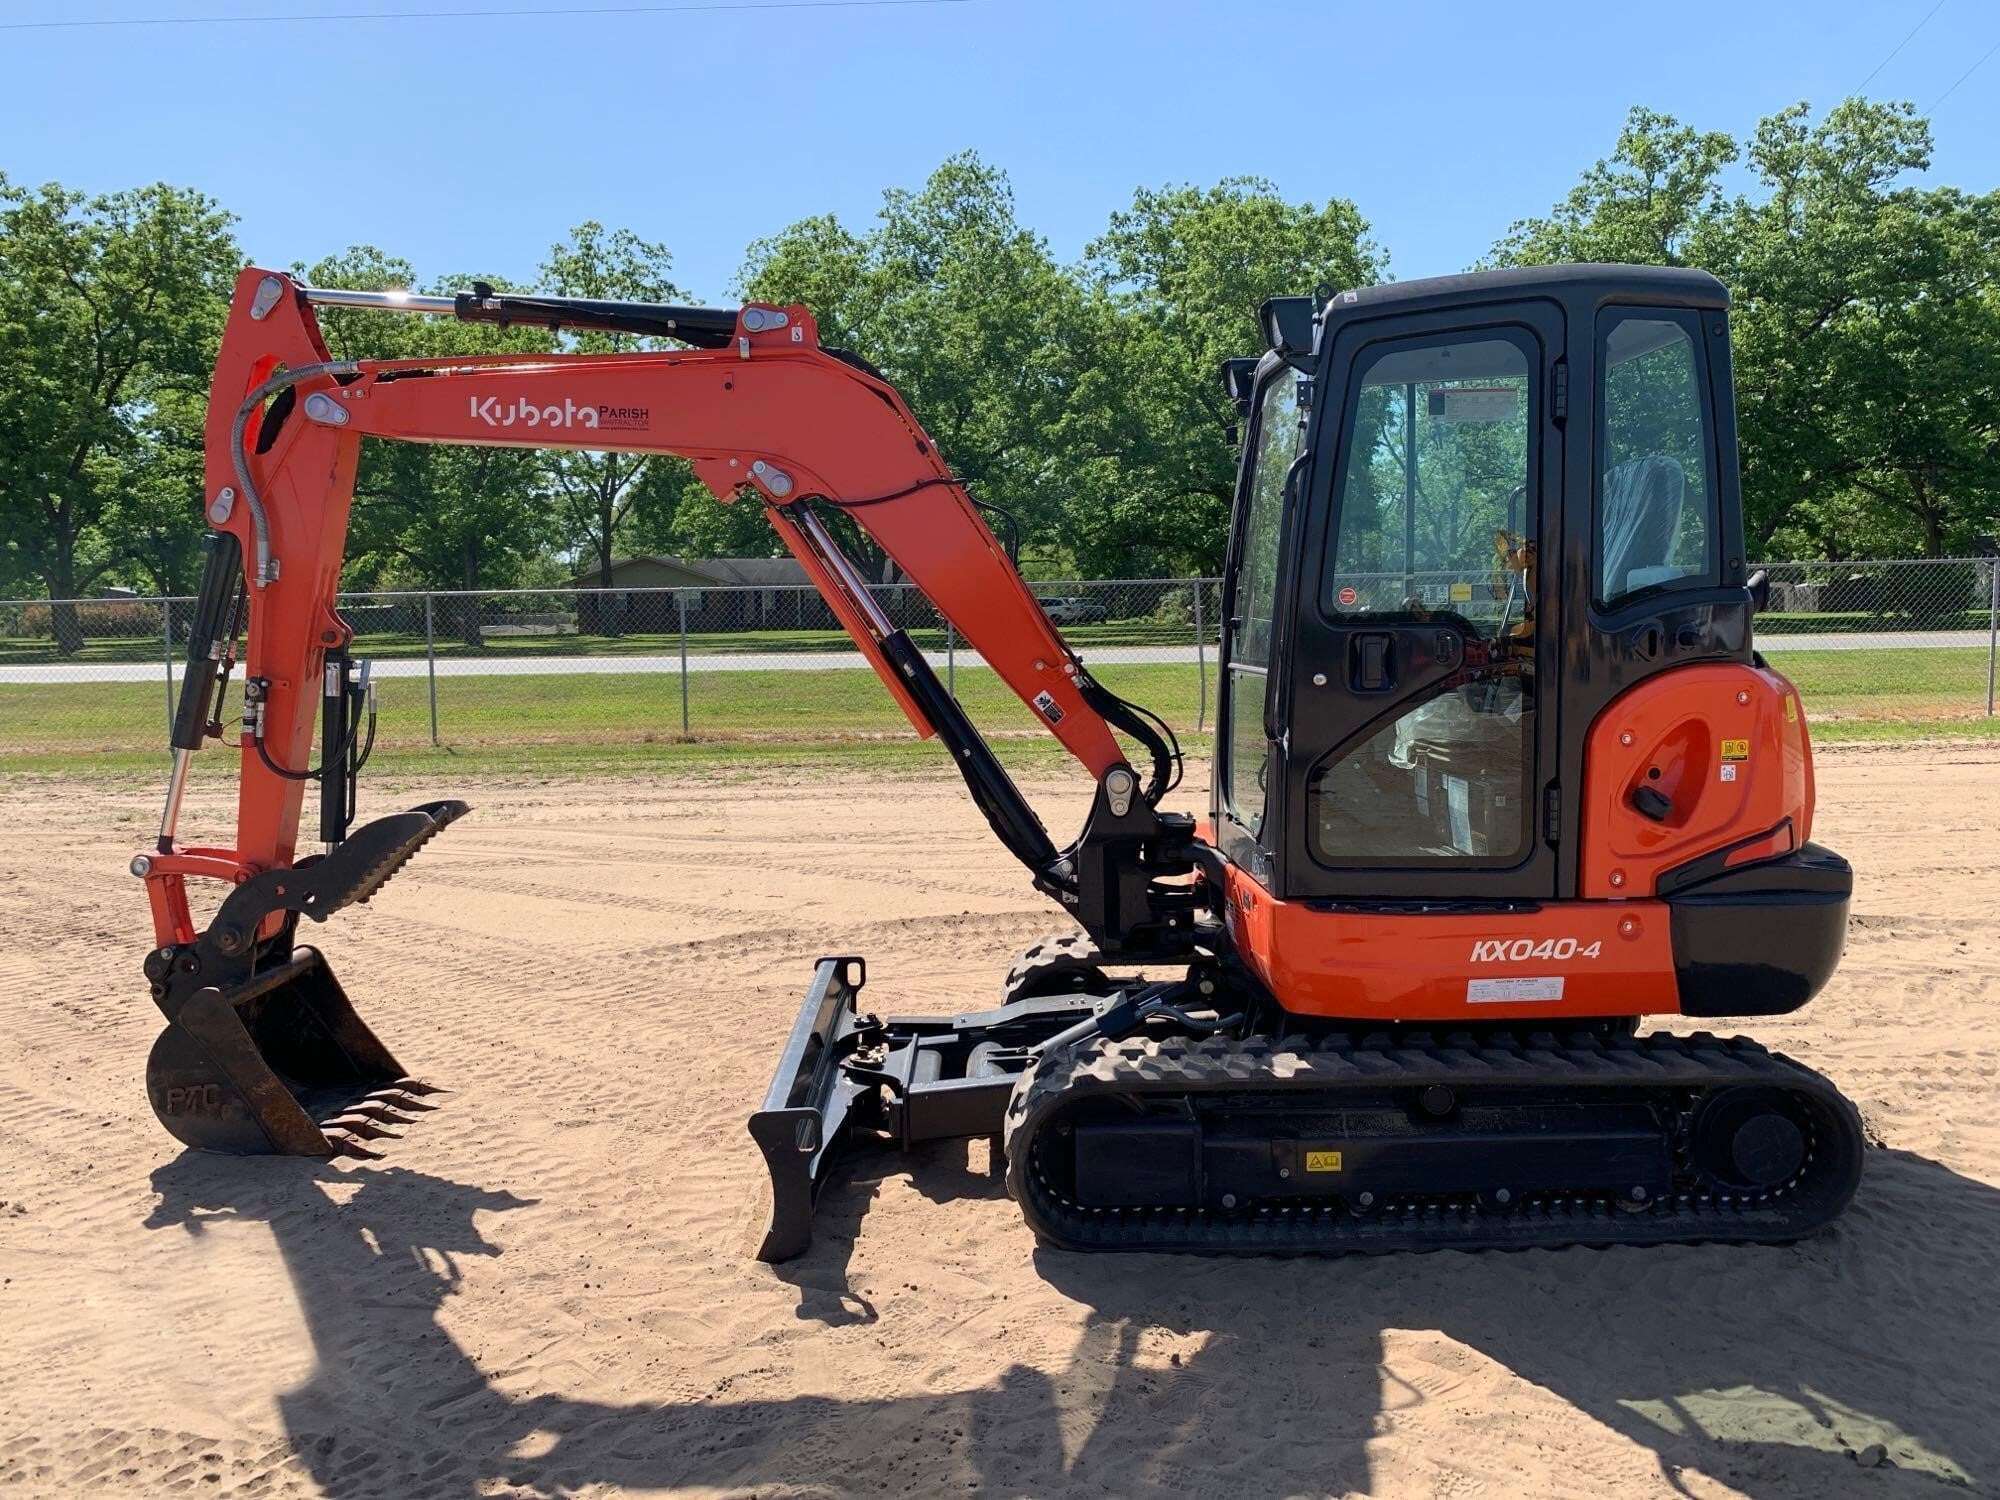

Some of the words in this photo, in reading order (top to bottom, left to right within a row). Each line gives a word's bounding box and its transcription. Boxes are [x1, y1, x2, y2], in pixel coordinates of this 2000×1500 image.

[470, 396, 598, 427] Kubota
[599, 405, 649, 419] PARISH
[1470, 938, 1602, 962] KX040-4
